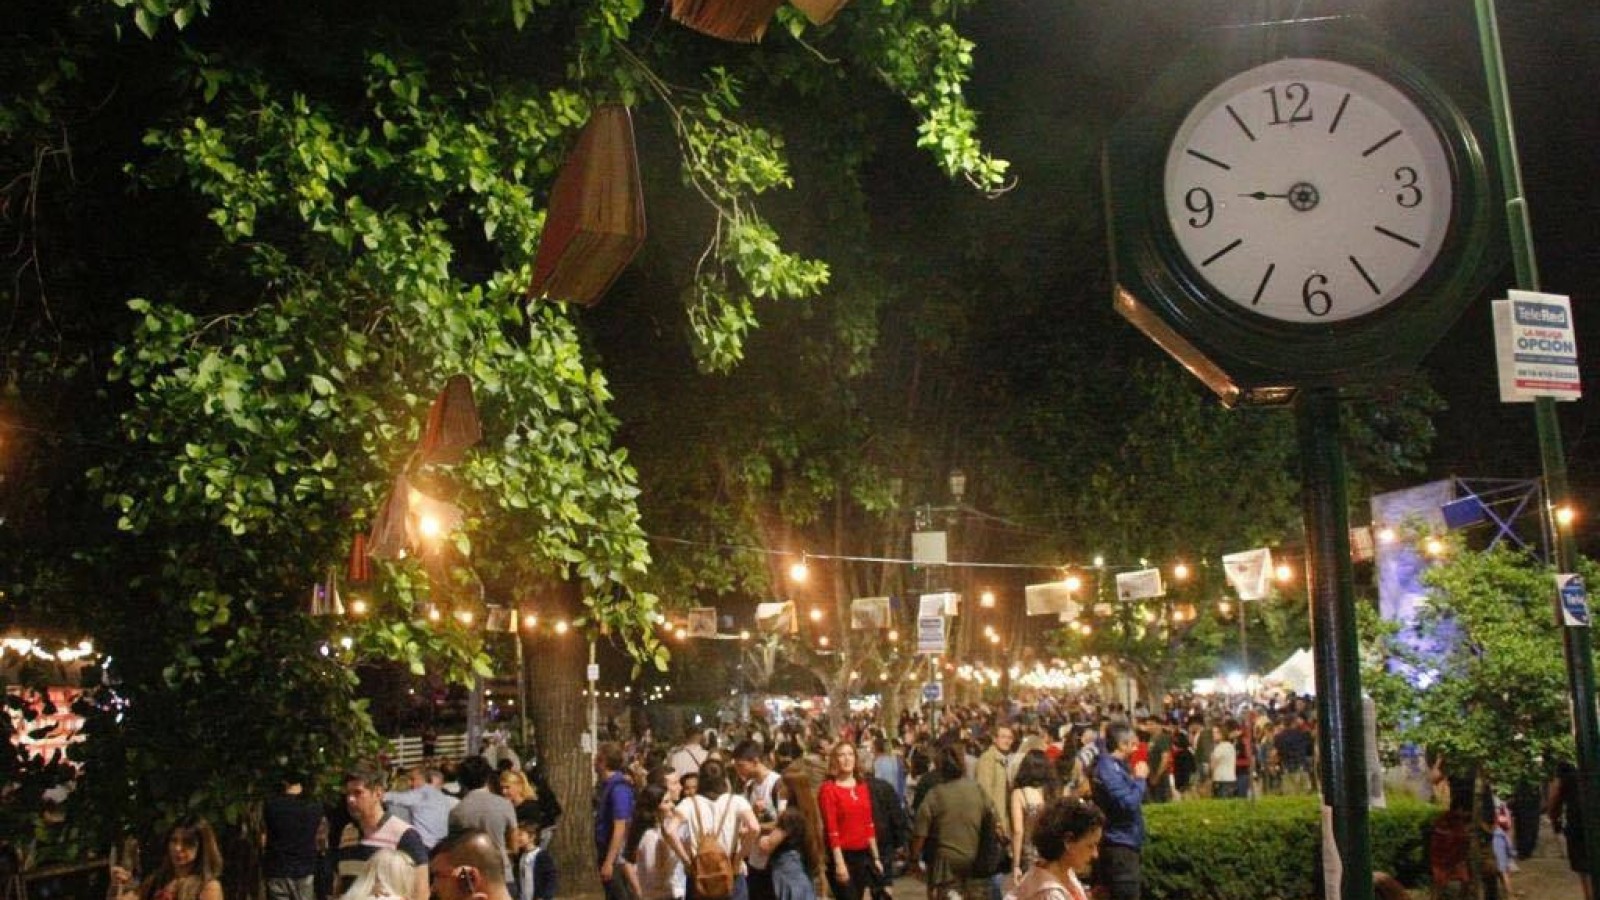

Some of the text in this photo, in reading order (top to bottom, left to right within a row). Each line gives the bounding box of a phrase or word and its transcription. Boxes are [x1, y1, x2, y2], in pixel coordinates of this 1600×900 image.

[1263, 82, 1313, 126] 12
[1185, 187, 1214, 229] 9
[1394, 166, 1422, 209] 3
[1302, 274, 1333, 317] 6
